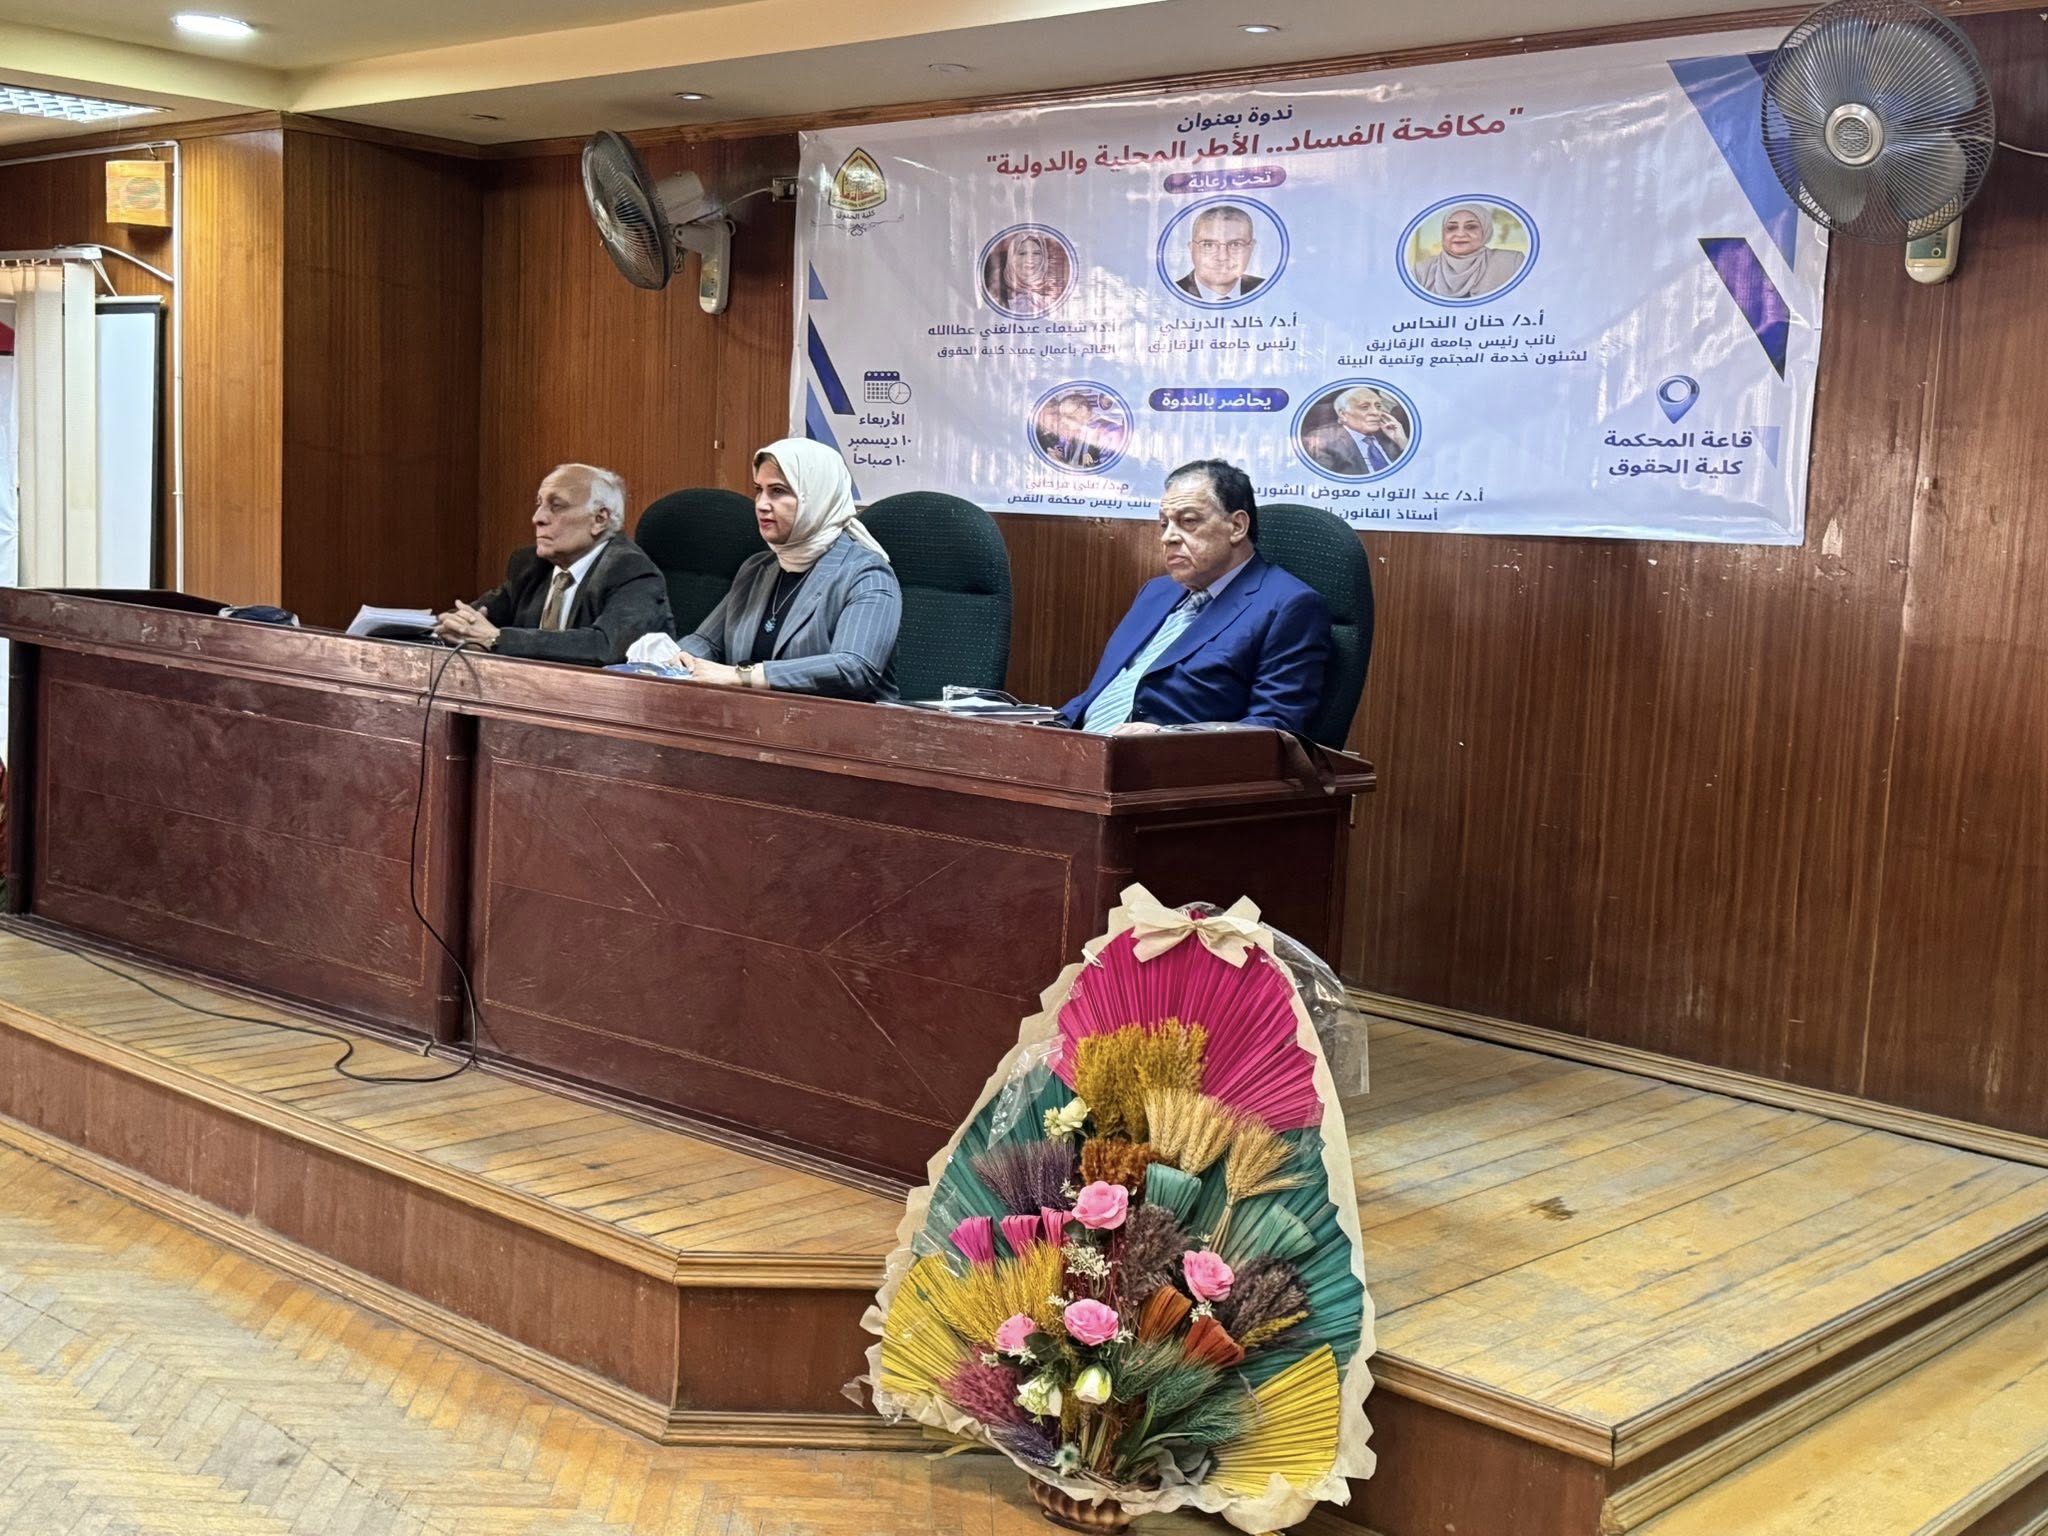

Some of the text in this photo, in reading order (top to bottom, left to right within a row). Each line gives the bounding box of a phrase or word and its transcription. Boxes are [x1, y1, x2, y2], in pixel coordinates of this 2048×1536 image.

[1177, 105, 1293, 133] ندوة بعنوان
[986, 107, 1524, 180] "مكافحة الفساد.. الأطر المحلية والدولية"
[1187, 170, 1271, 189] تحت رعاية
[1045, 321, 1088, 337] شيماء
[1159, 312, 1298, 336] أ.د/ خالد الدرندلي
[1392, 309, 1545, 333] أ.د/ حنان النحاس
[979, 323, 1040, 340] عبدالغني
[981, 344, 1005, 357] كلية
[1040, 343, 1077, 358] بأعمال
[1147, 337, 1296, 353] رئيس جامعة الزقازيق
[1366, 334, 1556, 352] نائب رئيس جامعة الزقازيق
[937, 345, 977, 358] الحقوق
[1337, 351, 1588, 368] لشئون خدمة المجتمع وتنمية البيئة
[1162, 392, 1271, 410] يحاضر بالندوة
[859, 411, 905, 428] الأربعاء
[848, 437, 898, 449] ديسمبر
[1604, 430, 1753, 448] قاعة المحكمة
[1609, 457, 1744, 479] كلية الحقوق
[1007, 494, 1044, 505] النقض
[1048, 494, 1086, 505] محكمة
[1311, 486, 1361, 499] معوض
[1367, 488, 1416, 501] التواب
[1422, 490, 1450, 503] عبد
[1456, 488, 1484, 501] أ.د/
[1089, 497, 1123, 509] رئيس
[1338, 508, 1390, 521] القانون
[1397, 507, 1439, 521] أستاذ
